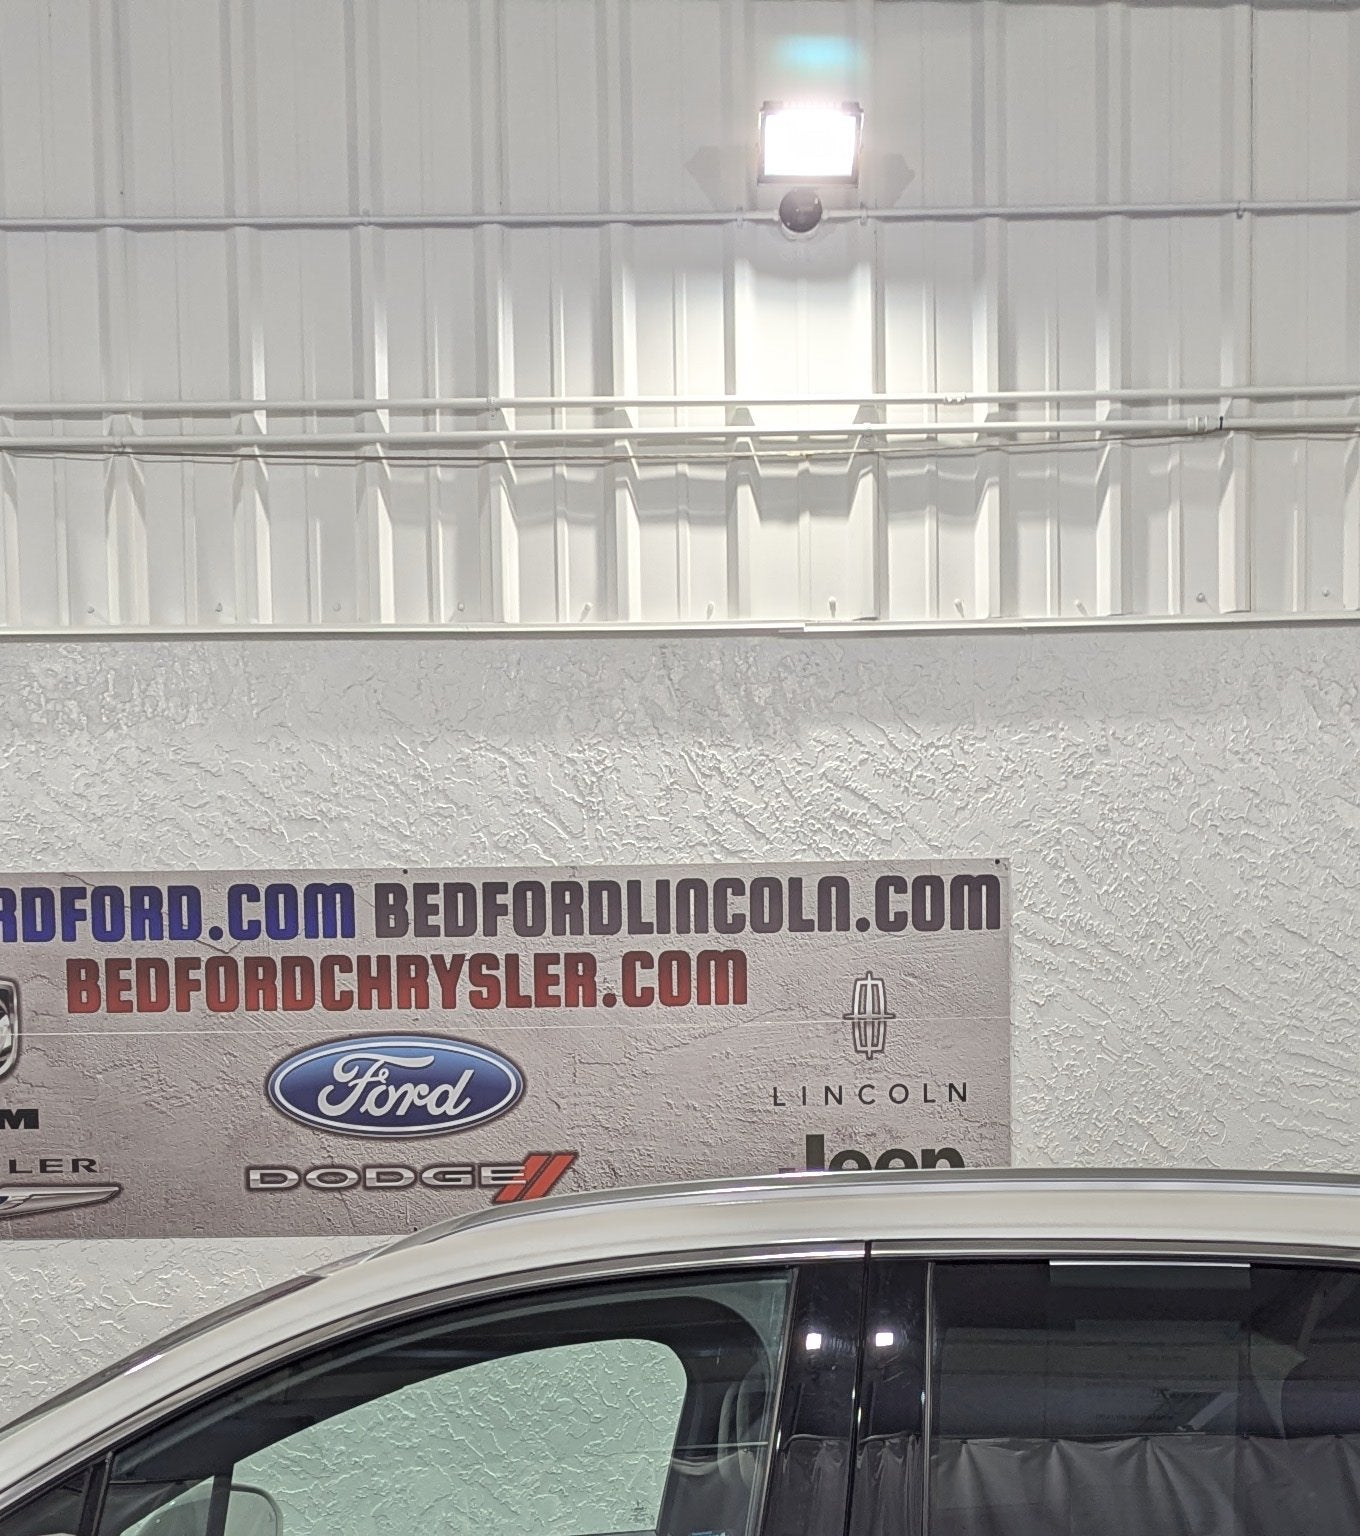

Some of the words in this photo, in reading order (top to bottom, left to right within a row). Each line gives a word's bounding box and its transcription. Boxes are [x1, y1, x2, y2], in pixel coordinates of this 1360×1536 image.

[375, 874, 1001, 938] BEDFORDLINCOLN.COM
[66, 949, 748, 1014] BEDFORDCHRYSLER.COM
[317, 1052, 475, 1117] Ford
[772, 1082, 967, 1107] LINCOLN
[249, 1165, 527, 1190] DODGE
